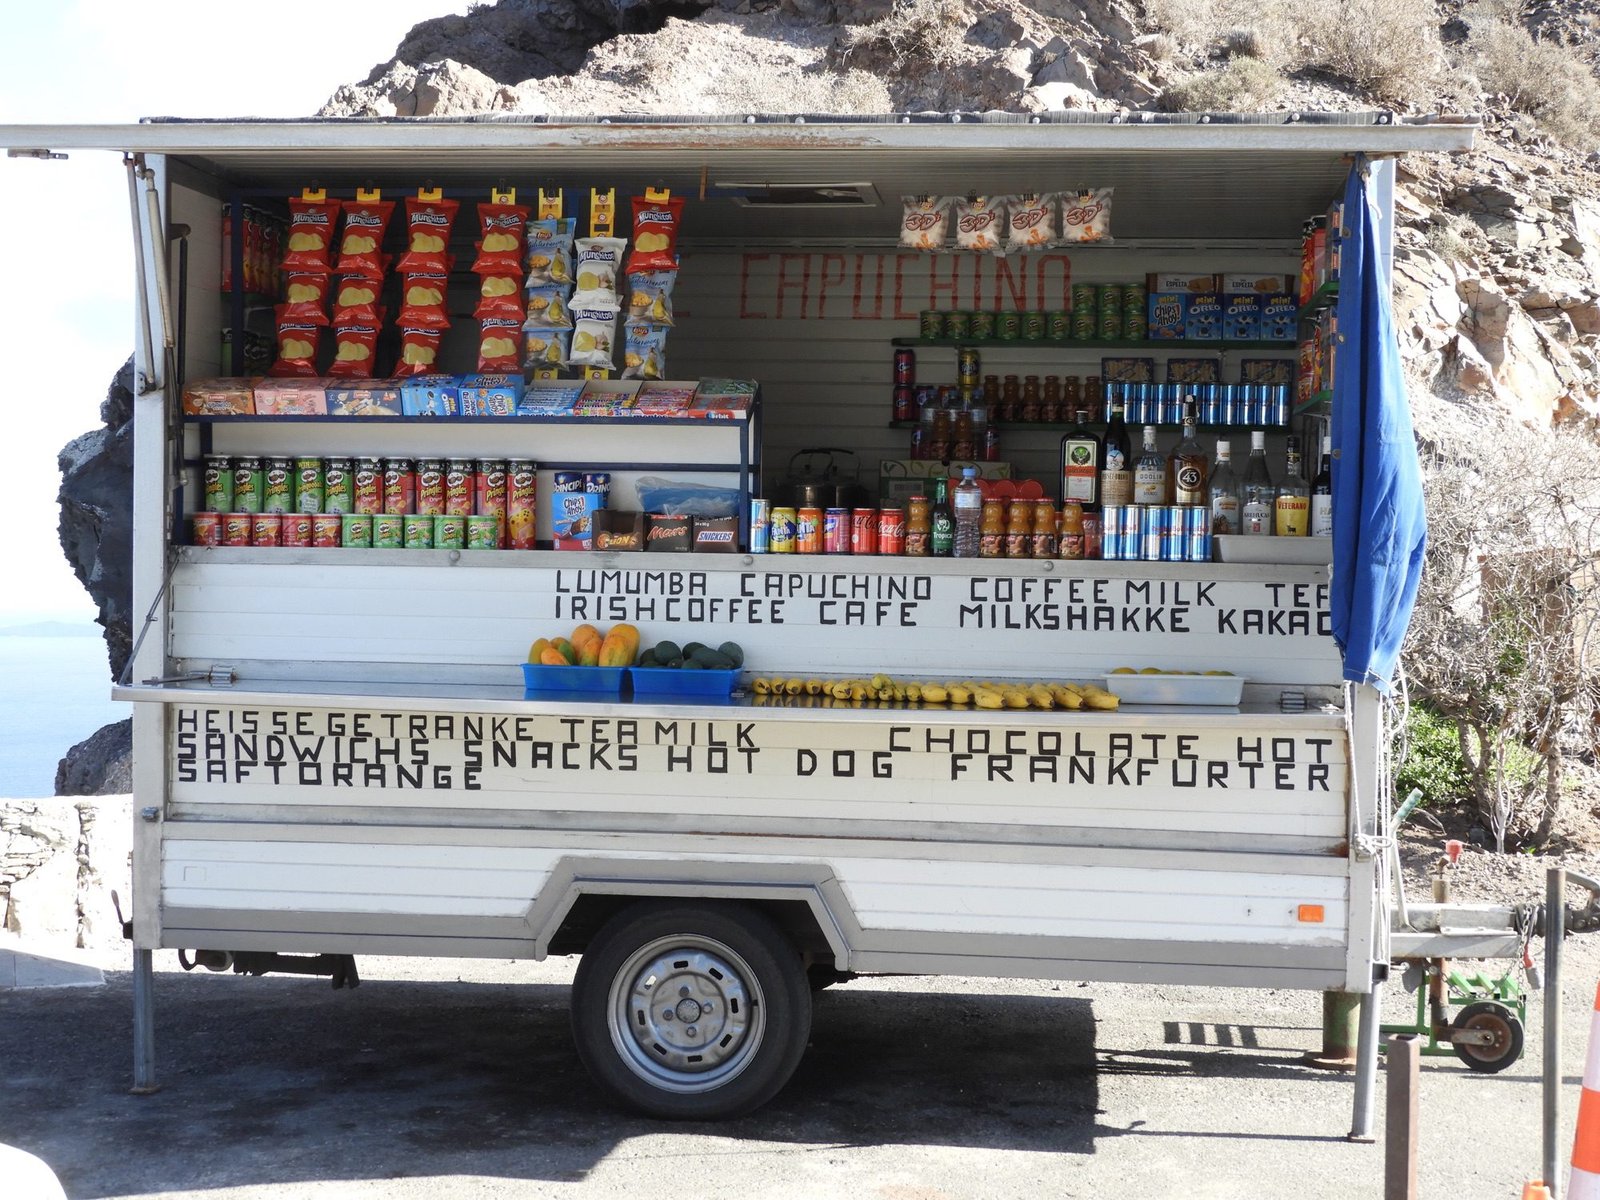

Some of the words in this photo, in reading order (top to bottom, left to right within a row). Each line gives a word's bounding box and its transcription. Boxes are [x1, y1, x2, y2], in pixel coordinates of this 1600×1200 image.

[579, 251, 616, 263] Munchitos
[739, 253, 1072, 320] CAPUCHINO
[1190, 305, 1221, 314] OREO
[1227, 305, 1259, 314] OREO
[1264, 305, 1297, 314] OREO
[1182, 472, 1197, 483] 43
[420, 485, 443, 500] Pringles
[512, 486, 535, 502] Pringles
[1278, 501, 1307, 510] VETERANO
[646, 526, 688, 541] Mars
[699, 532, 732, 541] SNICKERS
[609, 536, 631, 545] LION
[557, 570, 706, 595] LUMUMBA
[741, 574, 931, 600] CAPUCHINO
[820, 601, 917, 626] CAFE
[960, 604, 1189, 632] MILKSHAKKE
[890, 727, 1199, 759] CHOCOLATE
[1238, 737, 1332, 763] HOT
[178, 733, 429, 765] SANDWICHS
[465, 740, 637, 771] SNACKS
[668, 746, 760, 774] HOT
[798, 749, 892, 778] DOG
[952, 754, 1330, 792] FRANKFURTER
